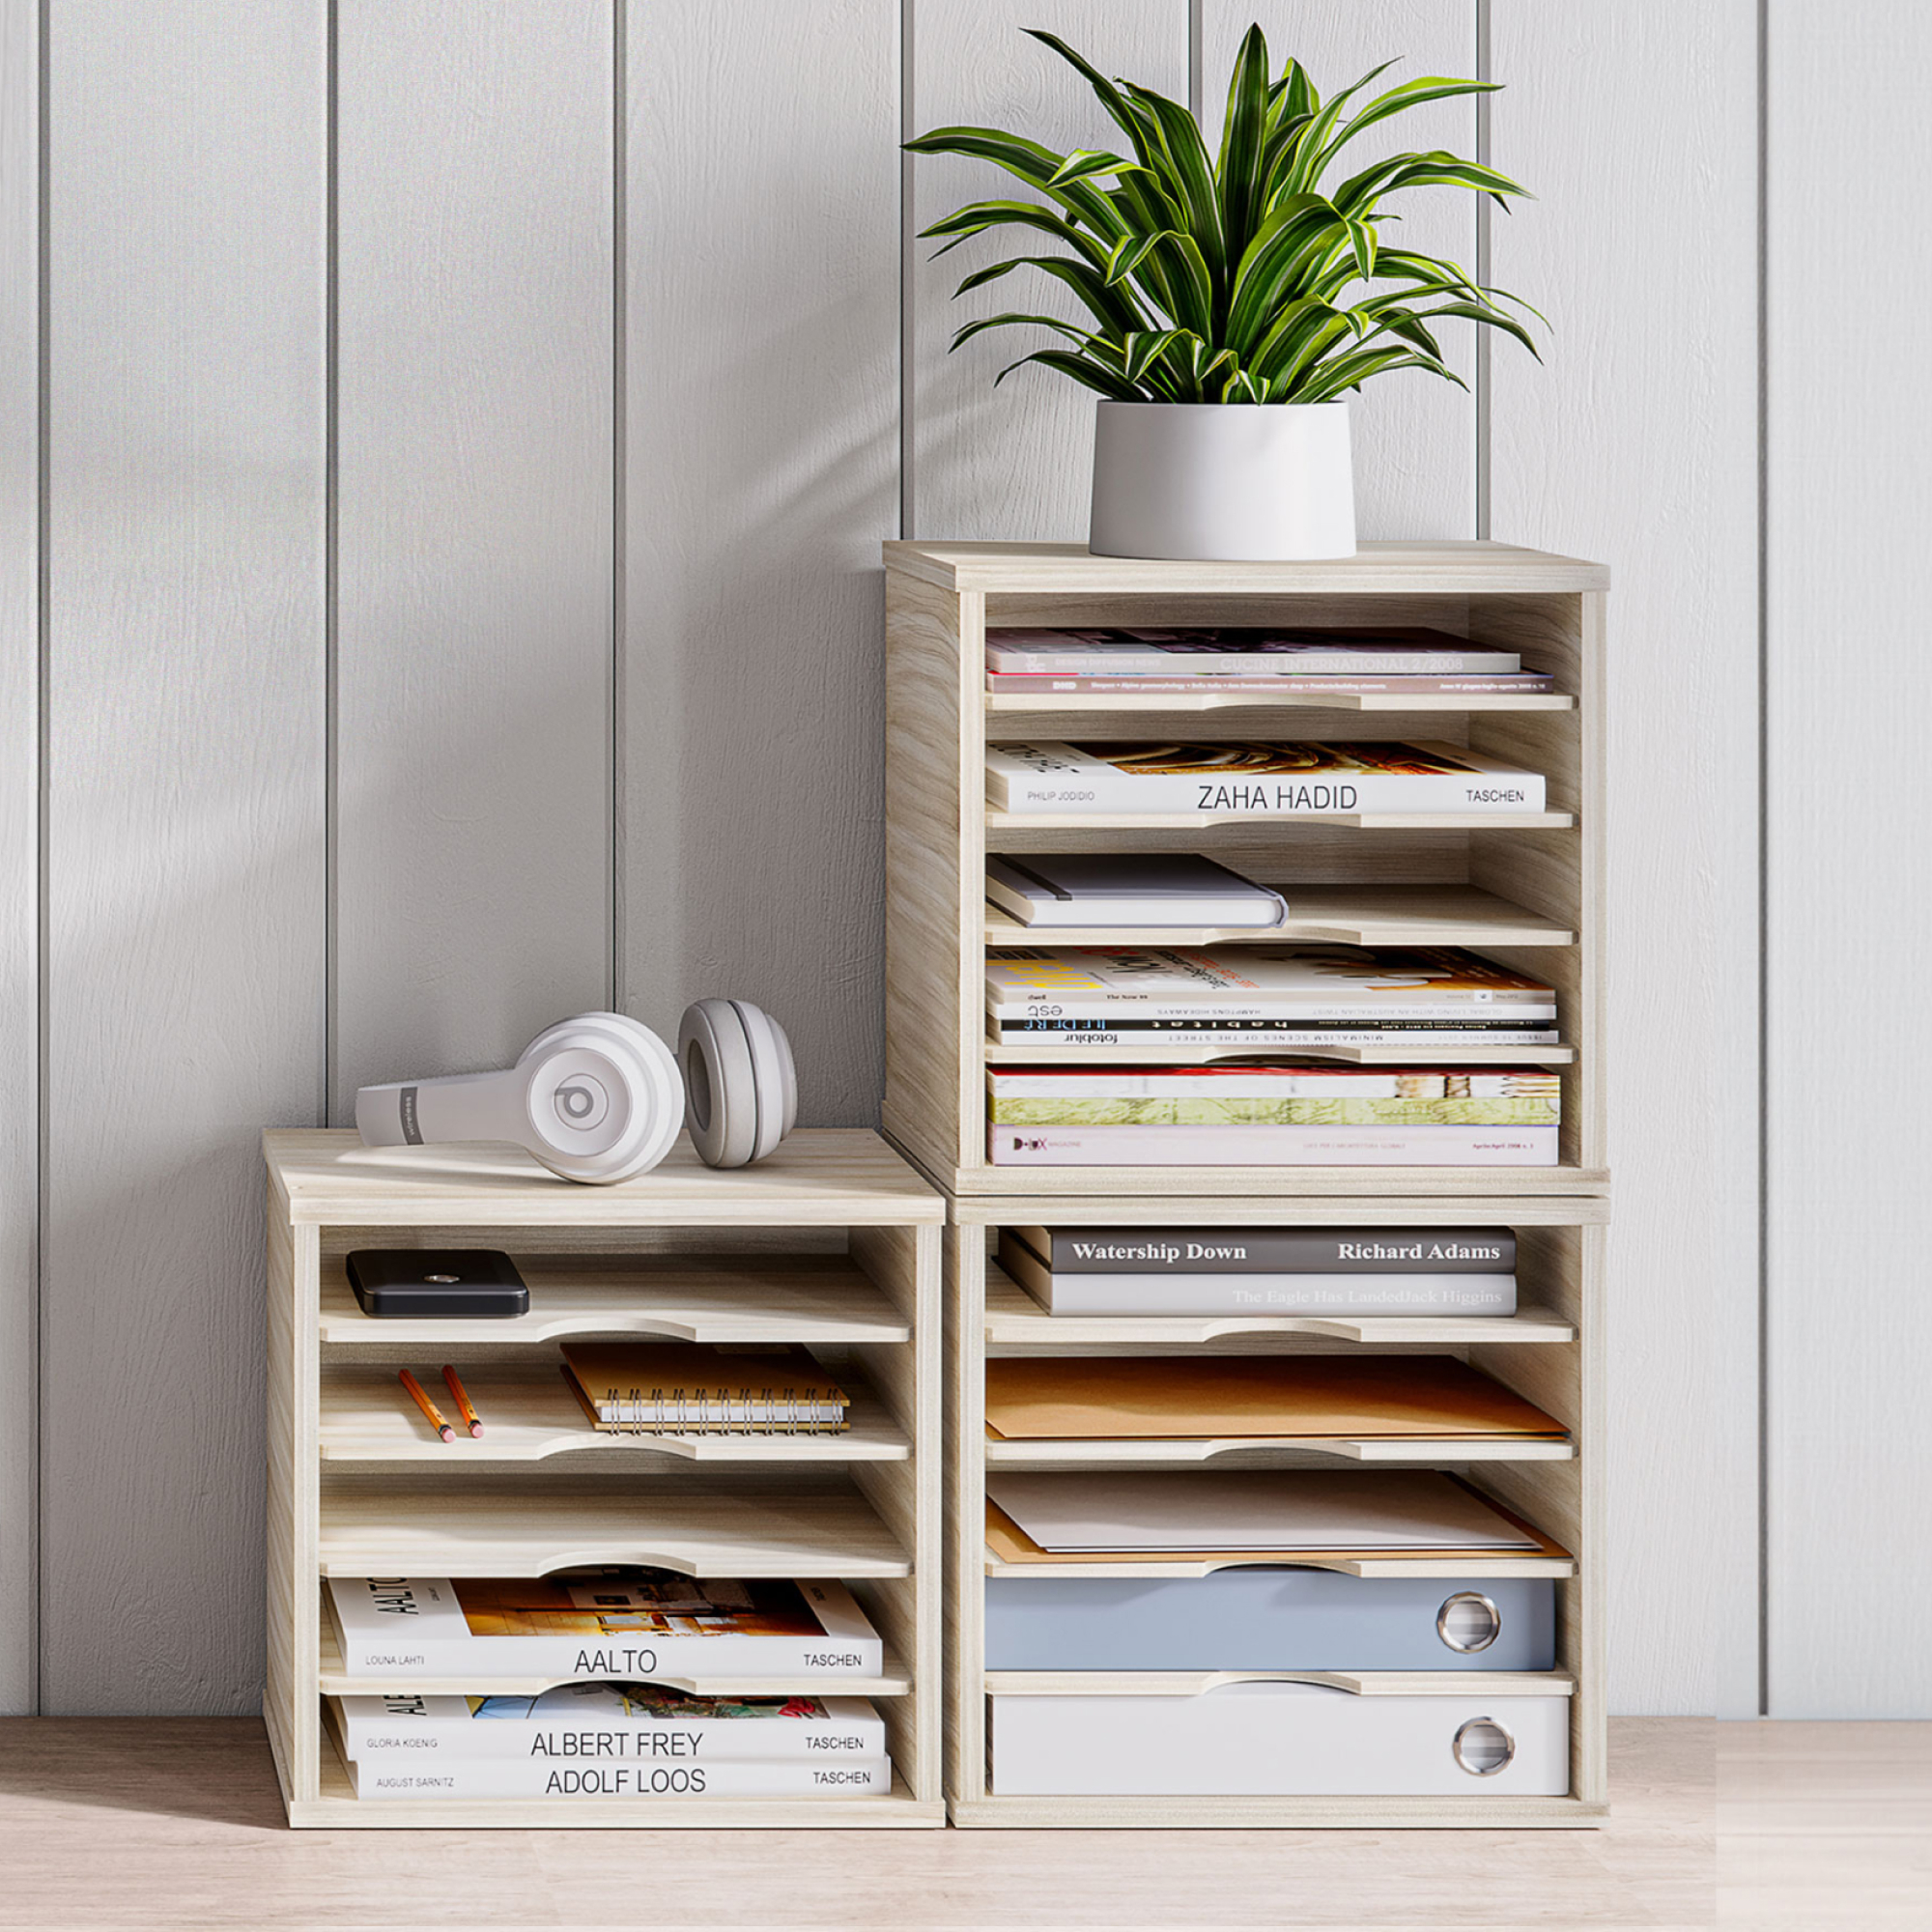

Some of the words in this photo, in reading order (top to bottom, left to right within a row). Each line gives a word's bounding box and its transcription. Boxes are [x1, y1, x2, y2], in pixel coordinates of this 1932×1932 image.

[1220, 658, 1279, 670] CUCINE
[1284, 658, 1407, 670] INTERNATIONAL
[1412, 658, 1464, 671] 2/2008
[1027, 790, 1056, 801] PHILIP
[1058, 790, 1095, 801] JODIDIO
[1198, 785, 1268, 810] ZAHA
[1276, 785, 1358, 810] HADID
[1465, 789, 1525, 803] TASCHEN
[1027, 1006, 1064, 1018] est
[1064, 1034, 1119, 1044] fotoblur
[406, 1096, 416, 1137] wireless
[1071, 1242, 1180, 1264] Watership
[1186, 1242, 1247, 1260] Down
[1337, 1242, 1423, 1260] Richard
[1428, 1242, 1501, 1260] Adams
[1233, 1290, 1263, 1303] The
[1265, 1290, 1309, 1306] Eagle
[1313, 1290, 1344, 1303] Has
[1441, 1290, 1503, 1306] Higgins
[365, 1655, 397, 1665] LOUNA
[398, 1655, 425, 1665] LAHTI
[574, 1649, 658, 1674] AALTO
[803, 1654, 863, 1666] TASCHEN
[366, 1738, 401, 1748] GLORIA
[402, 1738, 439, 1748] KOENIG
[530, 1732, 630, 1756] ALBERT
[637, 1732, 704, 1756] FREY
[806, 1737, 865, 1749] TASCHEN
[376, 1776, 414, 1787] AUGUST
[415, 1776, 454, 1787] SARNITZ
[546, 1770, 629, 1795] ADOLF
[637, 1770, 706, 1795] LOOS
[812, 1772, 872, 1784] TASCHEN
